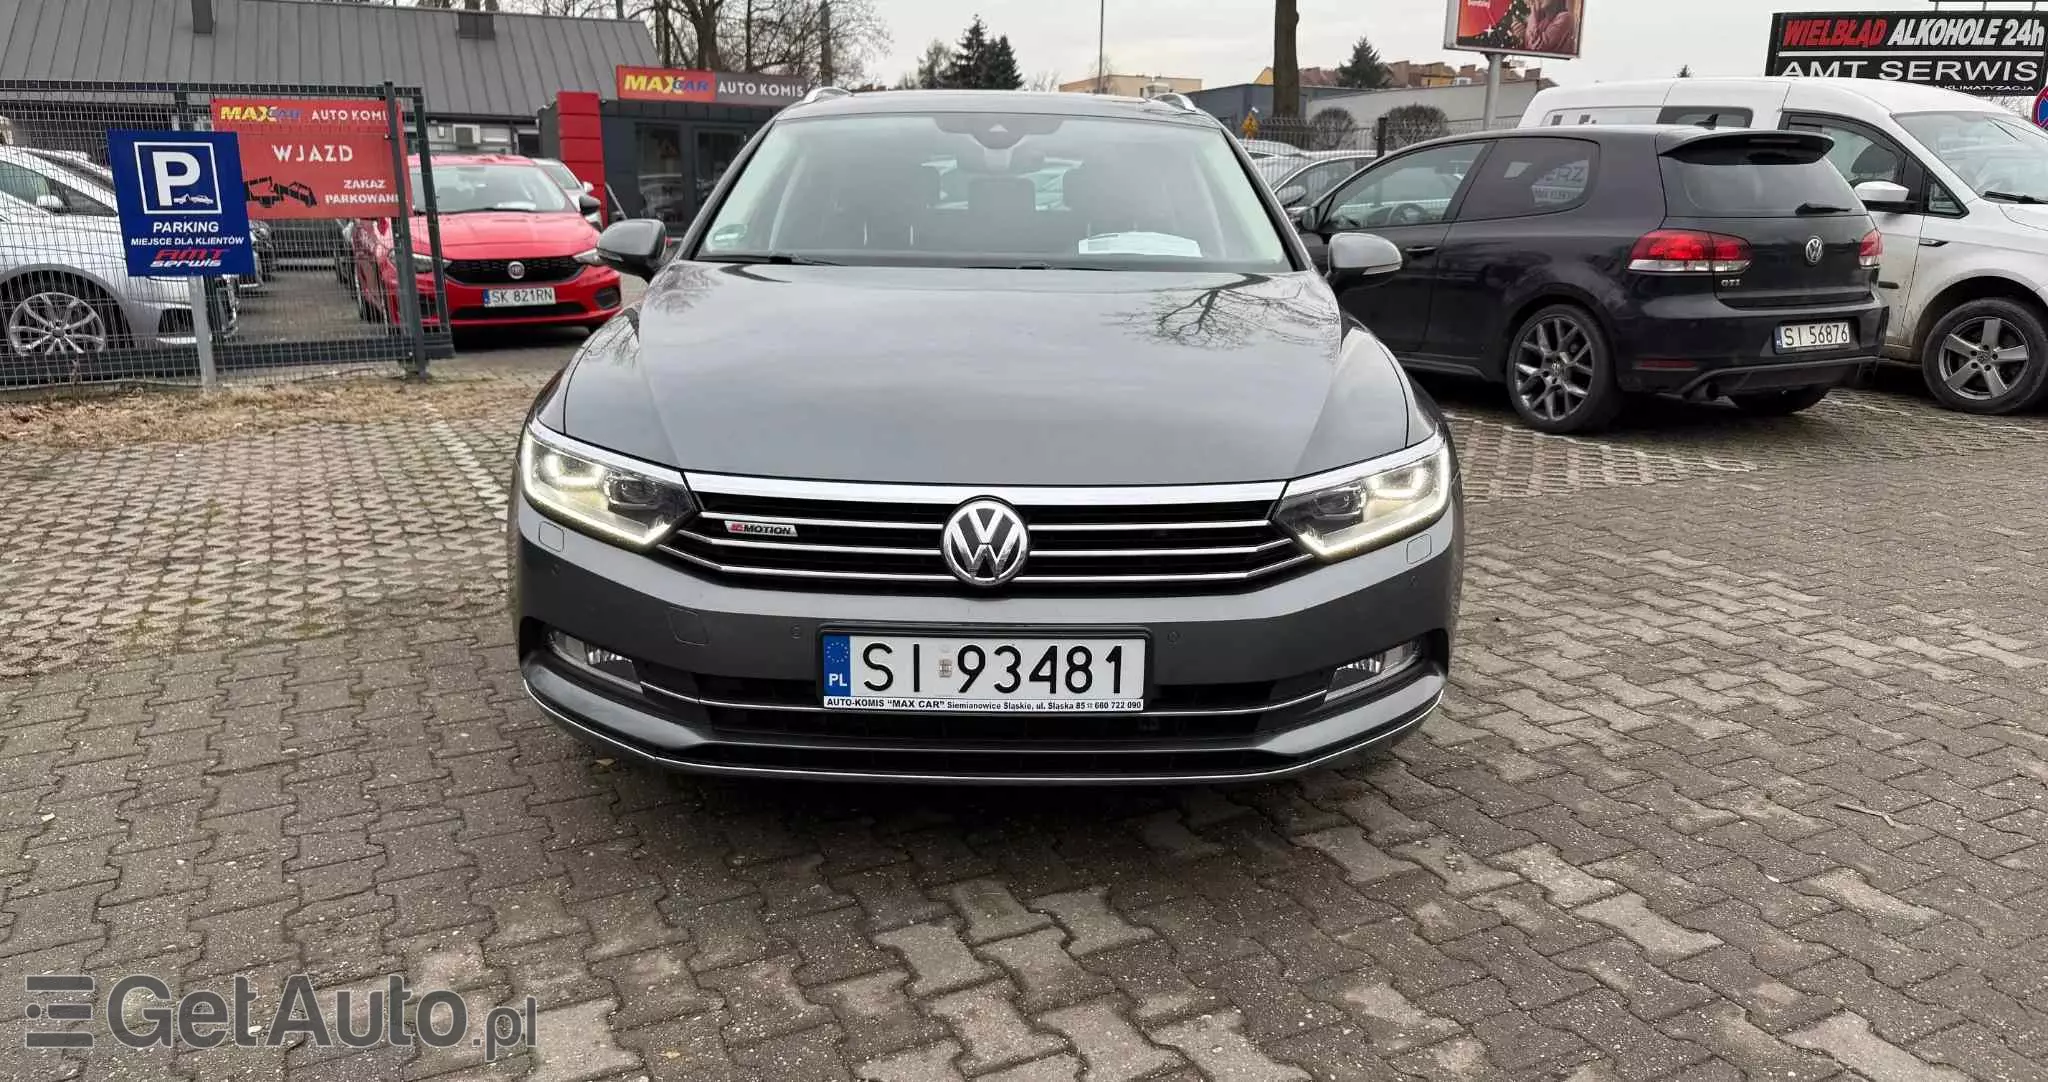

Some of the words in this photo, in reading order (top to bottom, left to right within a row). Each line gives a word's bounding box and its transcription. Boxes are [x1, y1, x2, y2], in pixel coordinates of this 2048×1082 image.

[1888, 18, 2002, 46] ALKOHOLE
[2001, 18, 2046, 46] 24h
[1781, 61, 1869, 78] AMT
[1879, 61, 2038, 81] SERWIS
[718, 81, 757, 95] AUTO
[760, 83, 805, 97] KOMIS
[311, 109, 348, 121] AUTO
[351, 109, 387, 121] KOMI
[271, 144, 353, 162] WJAZD
[152, 151, 201, 206] P
[344, 179, 386, 190] ZAKAZ
[325, 194, 399, 205] PARKOWANI
[153, 221, 219, 233] PARKING
[131, 237, 172, 246] MIEJSCE
[174, 237, 194, 246] DLA
[195, 236, 244, 246] KLIENTÓW
[1721, 278, 1741, 287] GTI
[492, 290, 508, 303] SK
[514, 287, 553, 302] 821RN
[1784, 327, 1802, 346] SI
[1809, 323, 1848, 345] 56876
[862, 642, 921, 692] SI
[957, 644, 1122, 694] 93481
[828, 673, 848, 687] PL
[826, 698, 885, 708] AUTO-KOMIS
[947, 701, 1000, 710] Siemianowice
